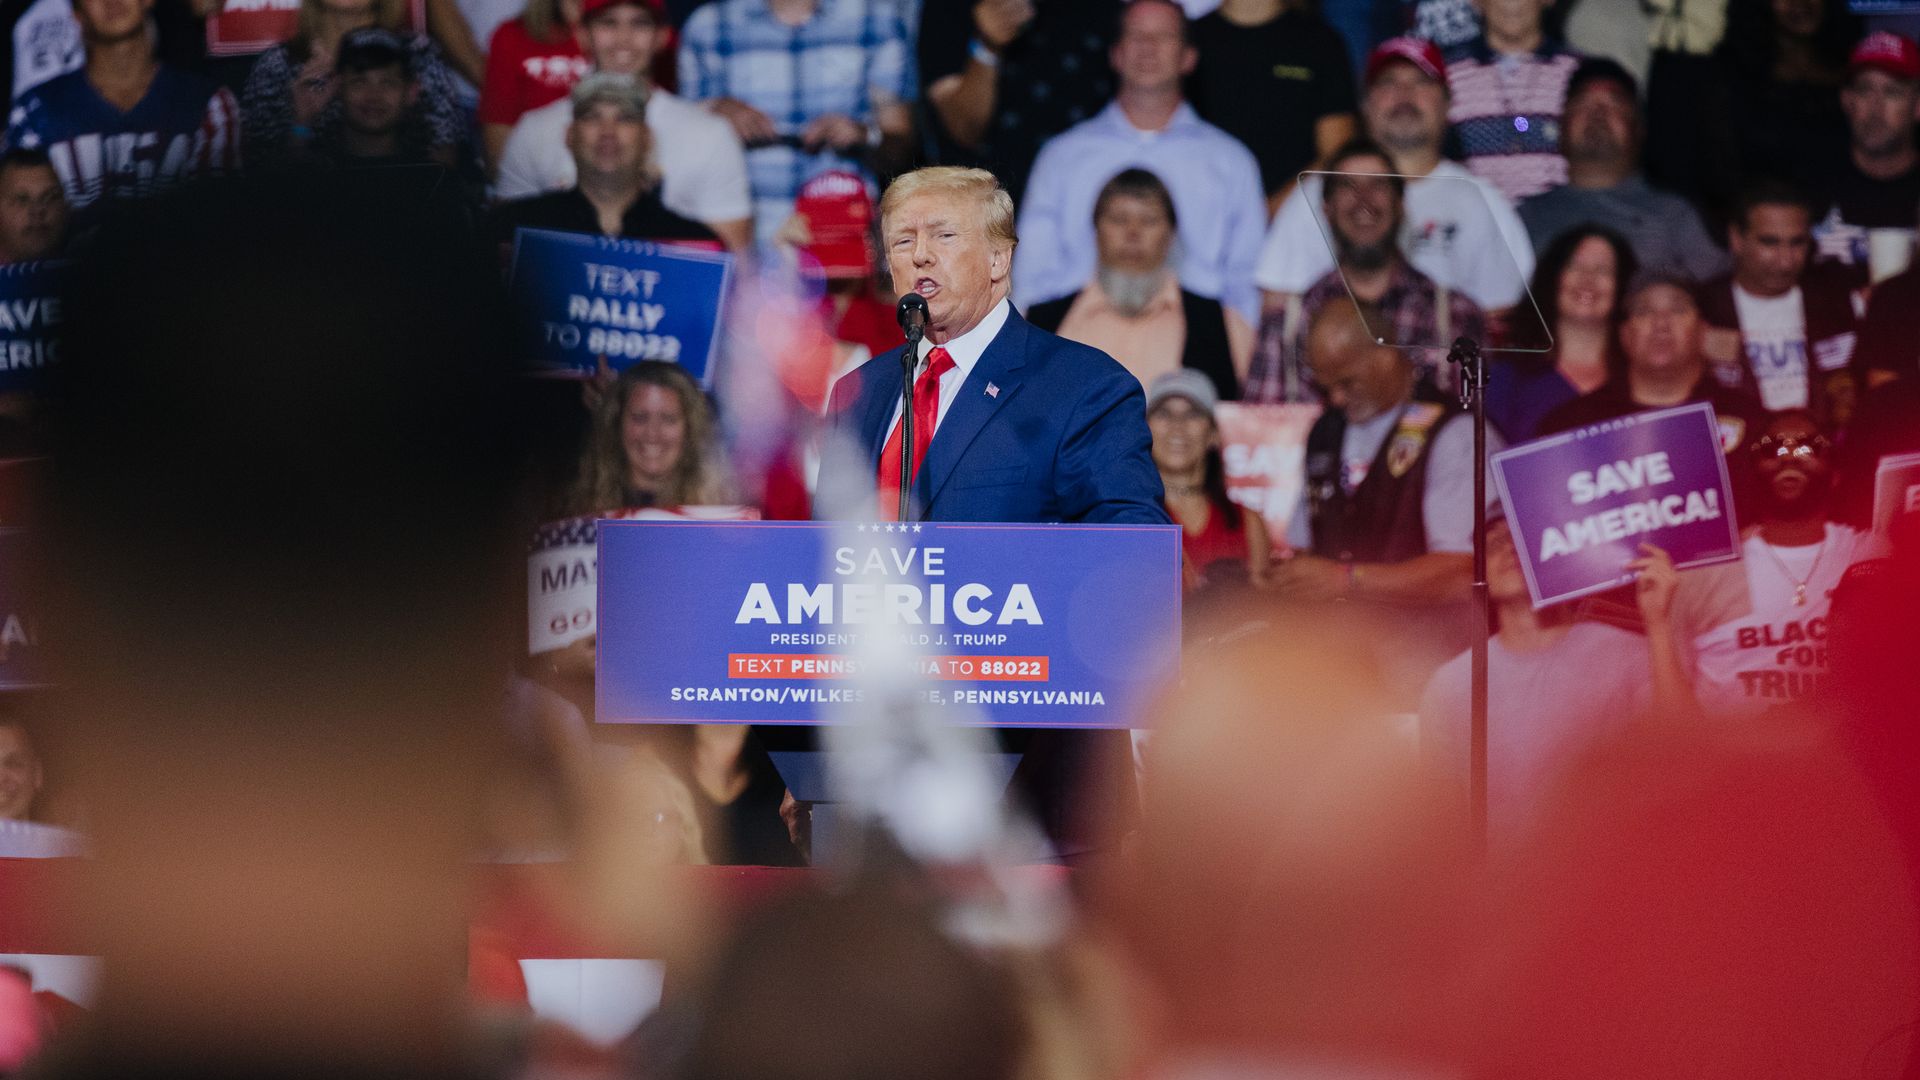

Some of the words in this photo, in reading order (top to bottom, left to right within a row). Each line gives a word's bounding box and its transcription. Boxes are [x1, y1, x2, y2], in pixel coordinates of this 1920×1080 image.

[584, 262, 661, 299] TEXT
[0, 297, 63, 333] AVE
[569, 294, 665, 332] RALLY
[544, 320, 580, 349] TO
[1567, 451, 1675, 506] SAVE
[1540, 488, 1721, 562] AMERICA!
[835, 547, 945, 576] SAVE
[735, 583, 1044, 626] AMERICA
[770, 633, 857, 645] PRESIDENT
[935, 634, 948, 646] J.
[953, 634, 1007, 646] TRUMP
[1737, 617, 1828, 649] BLAC
[735, 659, 784, 673] TEXT
[791, 660, 940, 674] PENNSYNIA
[948, 661, 973, 675] TO
[980, 661, 1040, 676] 88022
[954, 690, 1105, 706] PENNSYLVANIA
